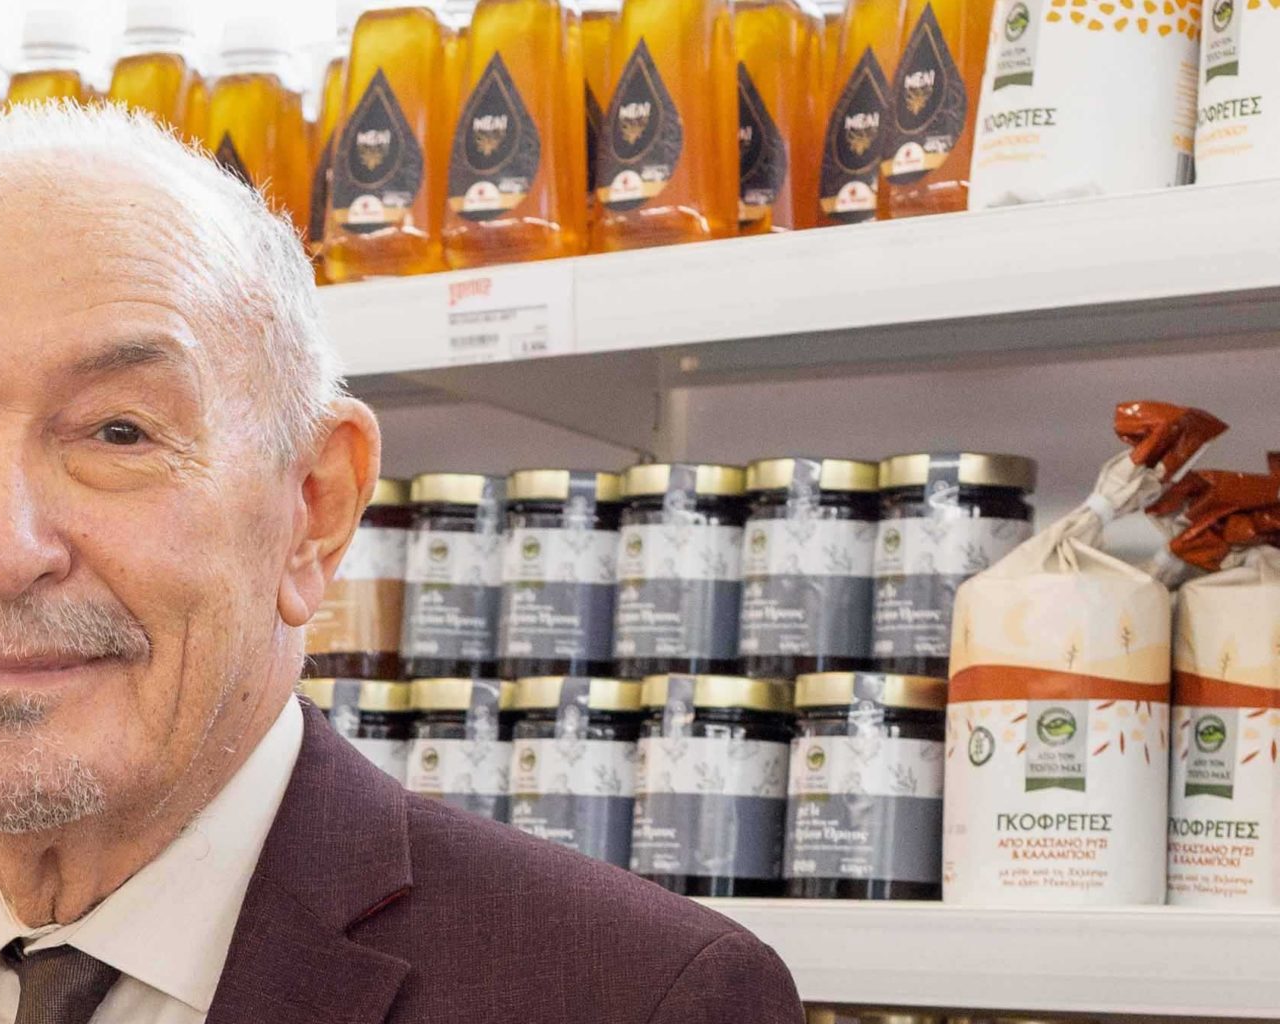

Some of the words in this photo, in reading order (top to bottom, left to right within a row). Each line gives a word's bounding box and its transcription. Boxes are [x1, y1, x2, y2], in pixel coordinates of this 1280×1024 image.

[1199, 96, 1261, 125] ΟΦΡΕΤΕΣ
[997, 813, 1112, 831] ΓΚΟΦΡΕΤΕΣ
[998, 838, 1023, 848] ΑΠΟ
[1026, 838, 1083, 848] ΚΑΣΤΑΝΟ
[1022, 850, 1096, 860] ΚΑΛΑΜΠΟΚΙ
